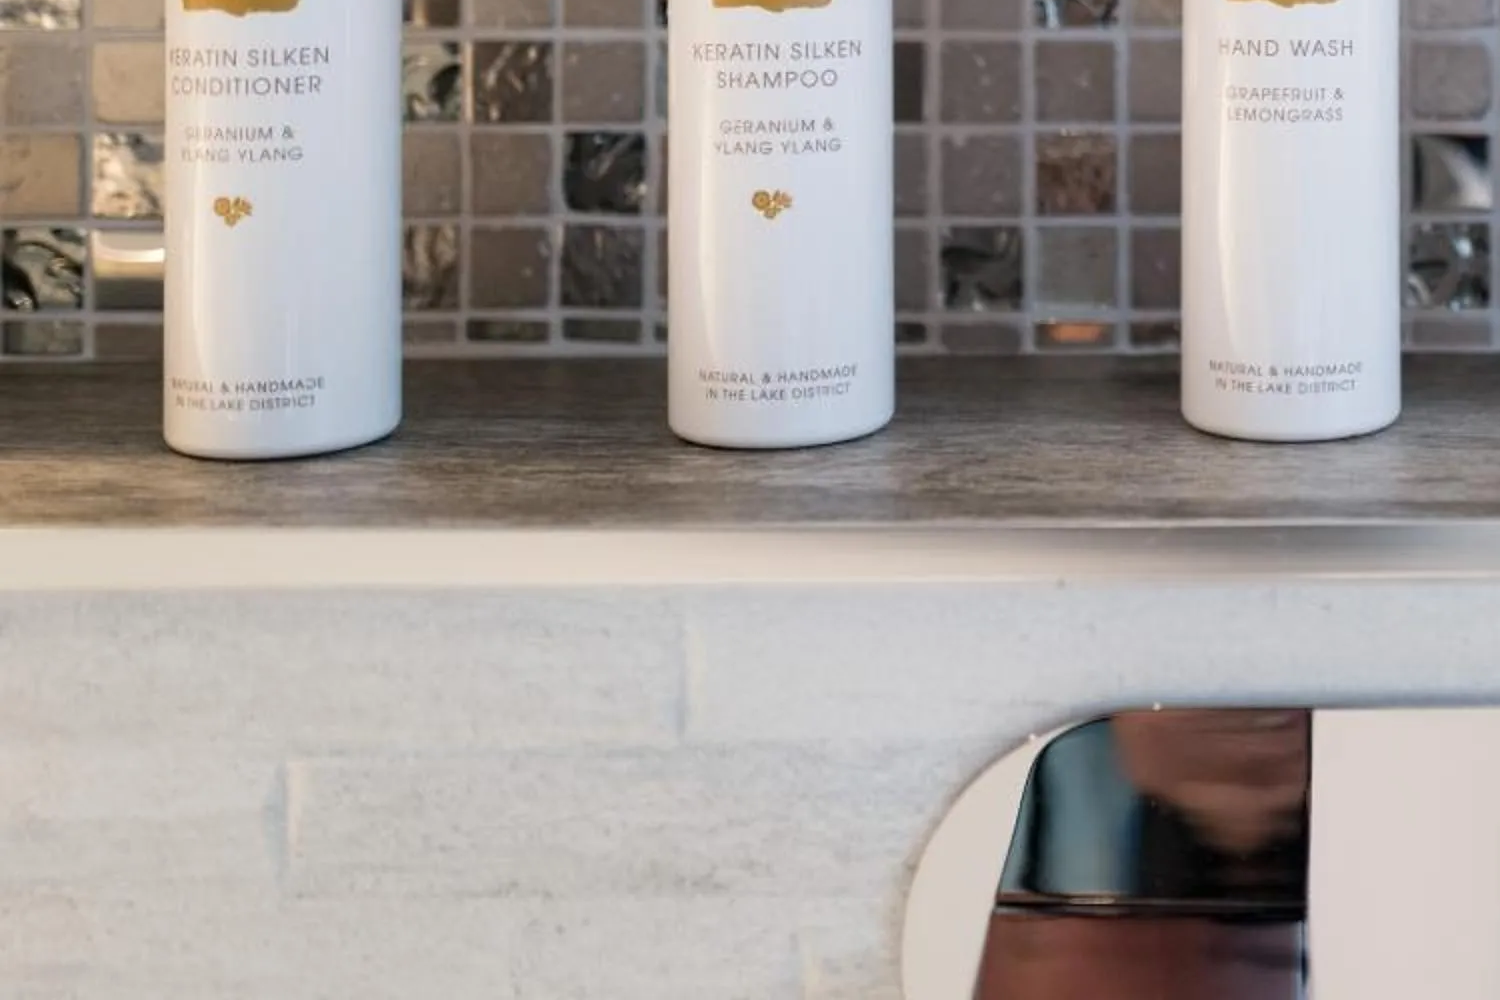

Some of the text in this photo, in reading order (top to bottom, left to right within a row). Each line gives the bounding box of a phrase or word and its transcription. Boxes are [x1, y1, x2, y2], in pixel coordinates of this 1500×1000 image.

[246, 46, 329, 67] SILKEN
[692, 40, 862, 62] KERATIN SILKEN
[1218, 39, 1354, 58] HAND WASH
[171, 74, 322, 96] CONDITIONER
[717, 69, 838, 89] SHAMPOO
[1227, 87, 1344, 101] GRAPEFRUIT &
[1228, 106, 1343, 122] LEMONGRASS
[281, 124, 294, 139] &
[719, 117, 833, 135] GERANIUM &
[238, 146, 303, 162] YLANG
[713, 138, 841, 156] YLANG YLANG
[699, 368, 754, 384] NATURAL
[762, 372, 771, 384] &
[1209, 359, 1262, 376] NATURAL
[1284, 362, 1363, 377] HANDMADE
[706, 382, 850, 401] IN THE LAKE DISTRICT
[1232, 379, 1255, 393] THE
[1257, 381, 1292, 395] LAKE
